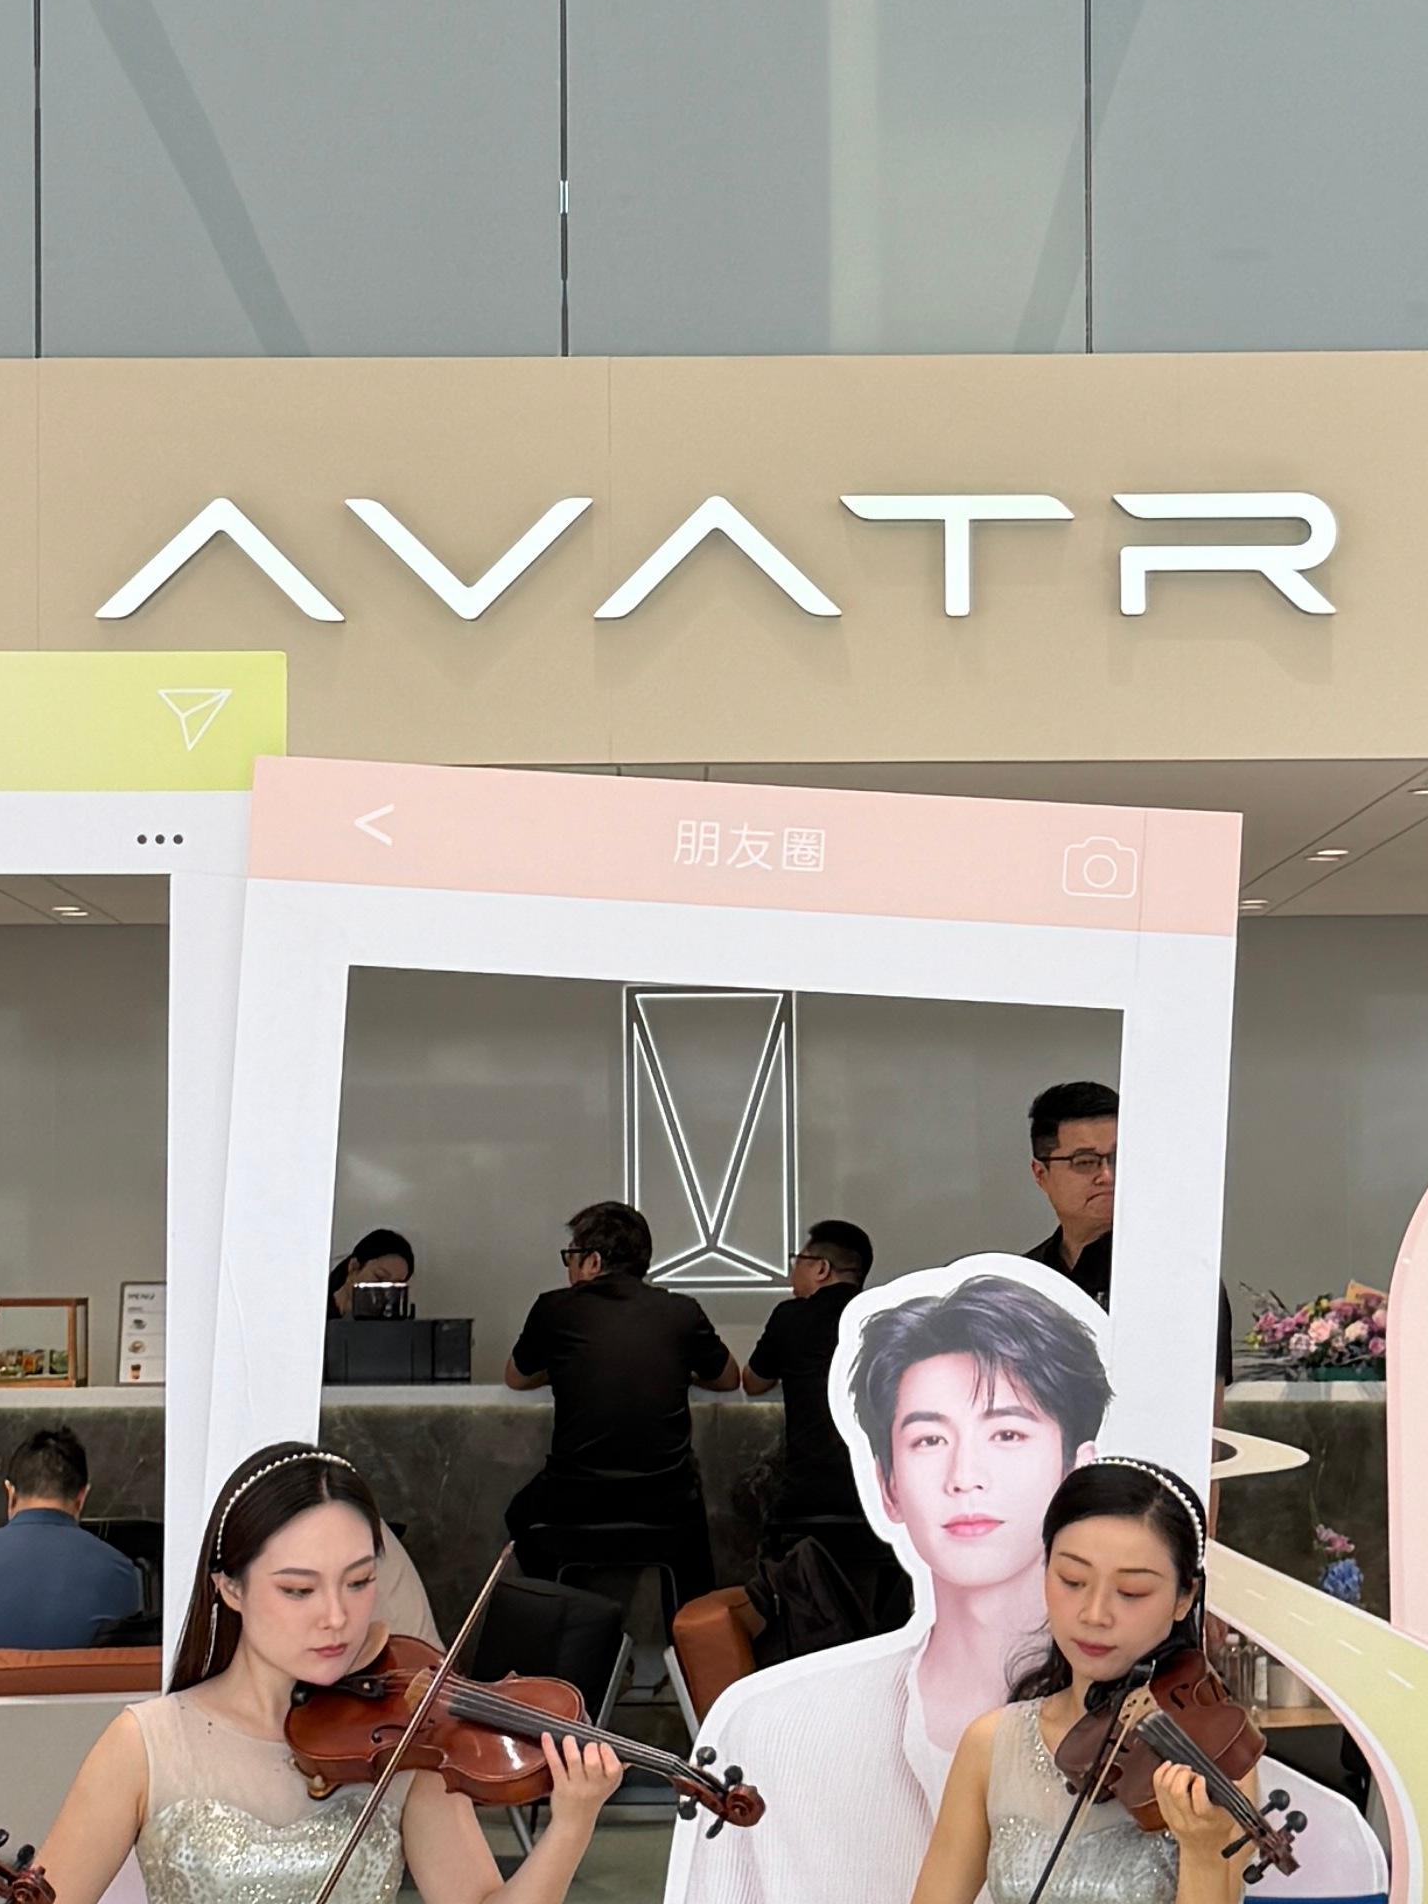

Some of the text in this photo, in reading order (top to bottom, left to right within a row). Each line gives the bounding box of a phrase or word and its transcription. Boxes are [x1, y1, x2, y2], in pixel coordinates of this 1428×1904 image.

[94, 492, 1337, 622] AVATR
[673, 819, 826, 873] 朋友圈
